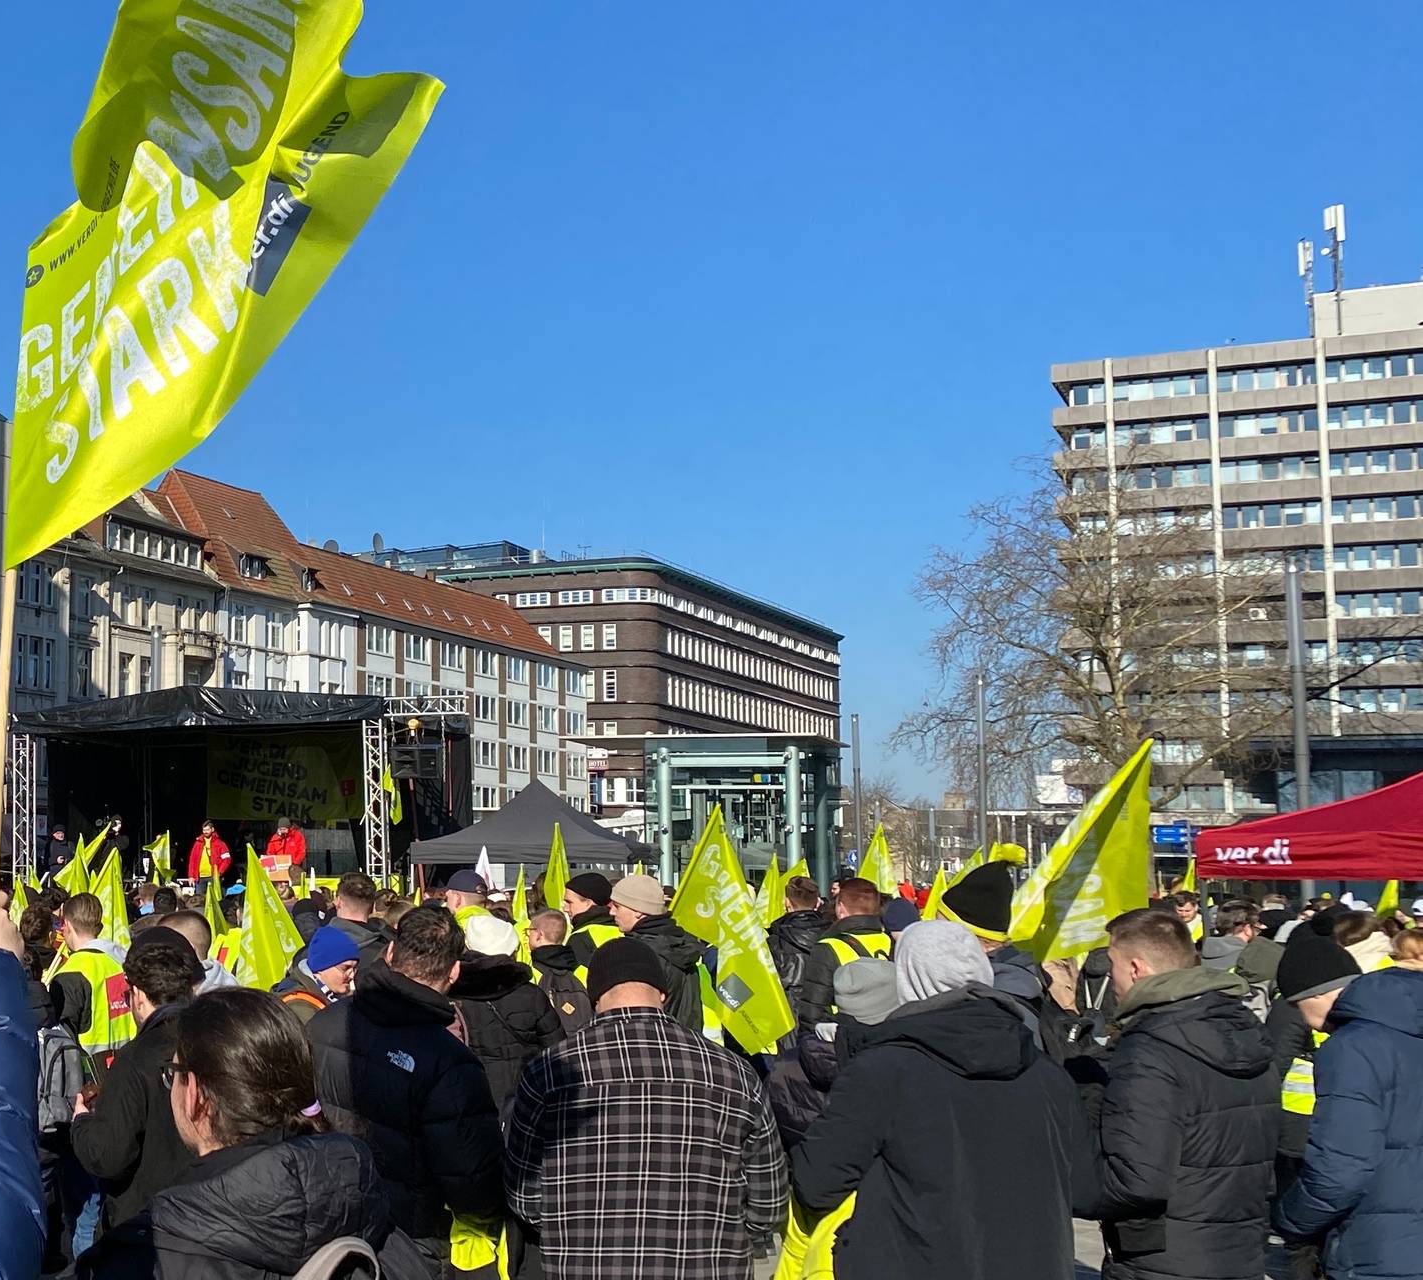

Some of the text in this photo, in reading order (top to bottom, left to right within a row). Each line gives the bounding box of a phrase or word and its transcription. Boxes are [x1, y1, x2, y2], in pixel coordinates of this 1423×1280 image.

[292, 112, 350, 183] UGEND
[251, 192, 294, 260] er.di
[233, 755, 308, 781] JUGEND
[217, 770, 327, 804] GEMEINSAM
[252, 796, 314, 820] STARK
[718, 984, 740, 1009] ver.di
